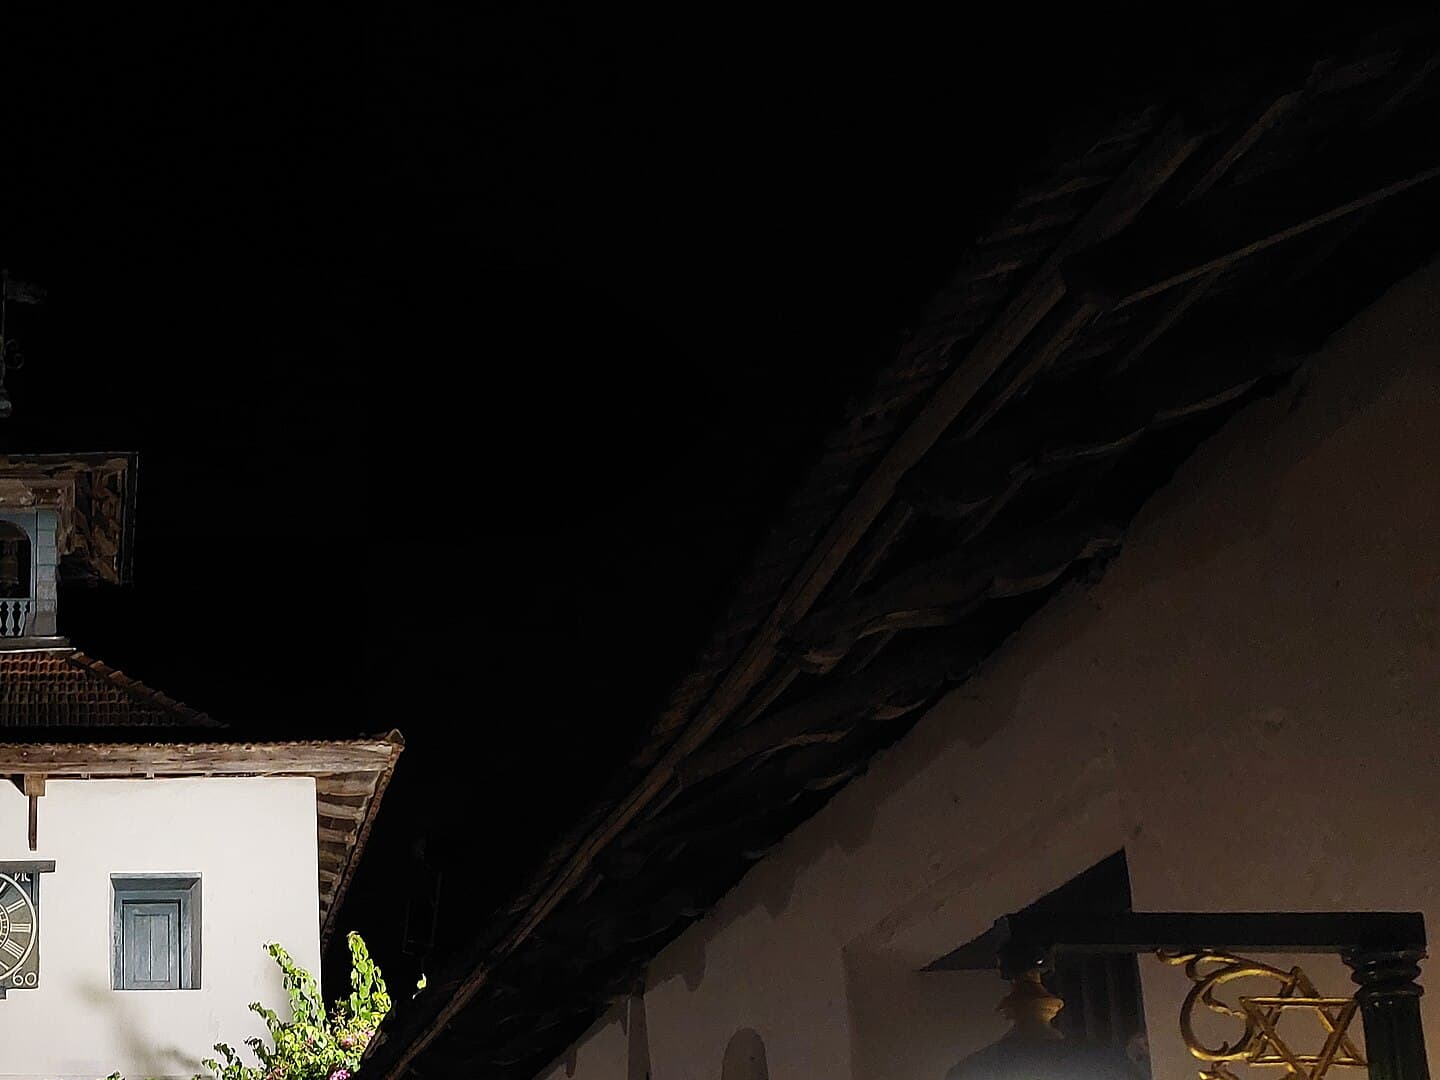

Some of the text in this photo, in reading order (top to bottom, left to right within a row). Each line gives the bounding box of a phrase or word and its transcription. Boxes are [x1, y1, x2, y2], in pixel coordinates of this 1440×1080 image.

[7, 898, 27, 913] II
[9, 922, 32, 933] III
[11, 967, 37, 986] 60
